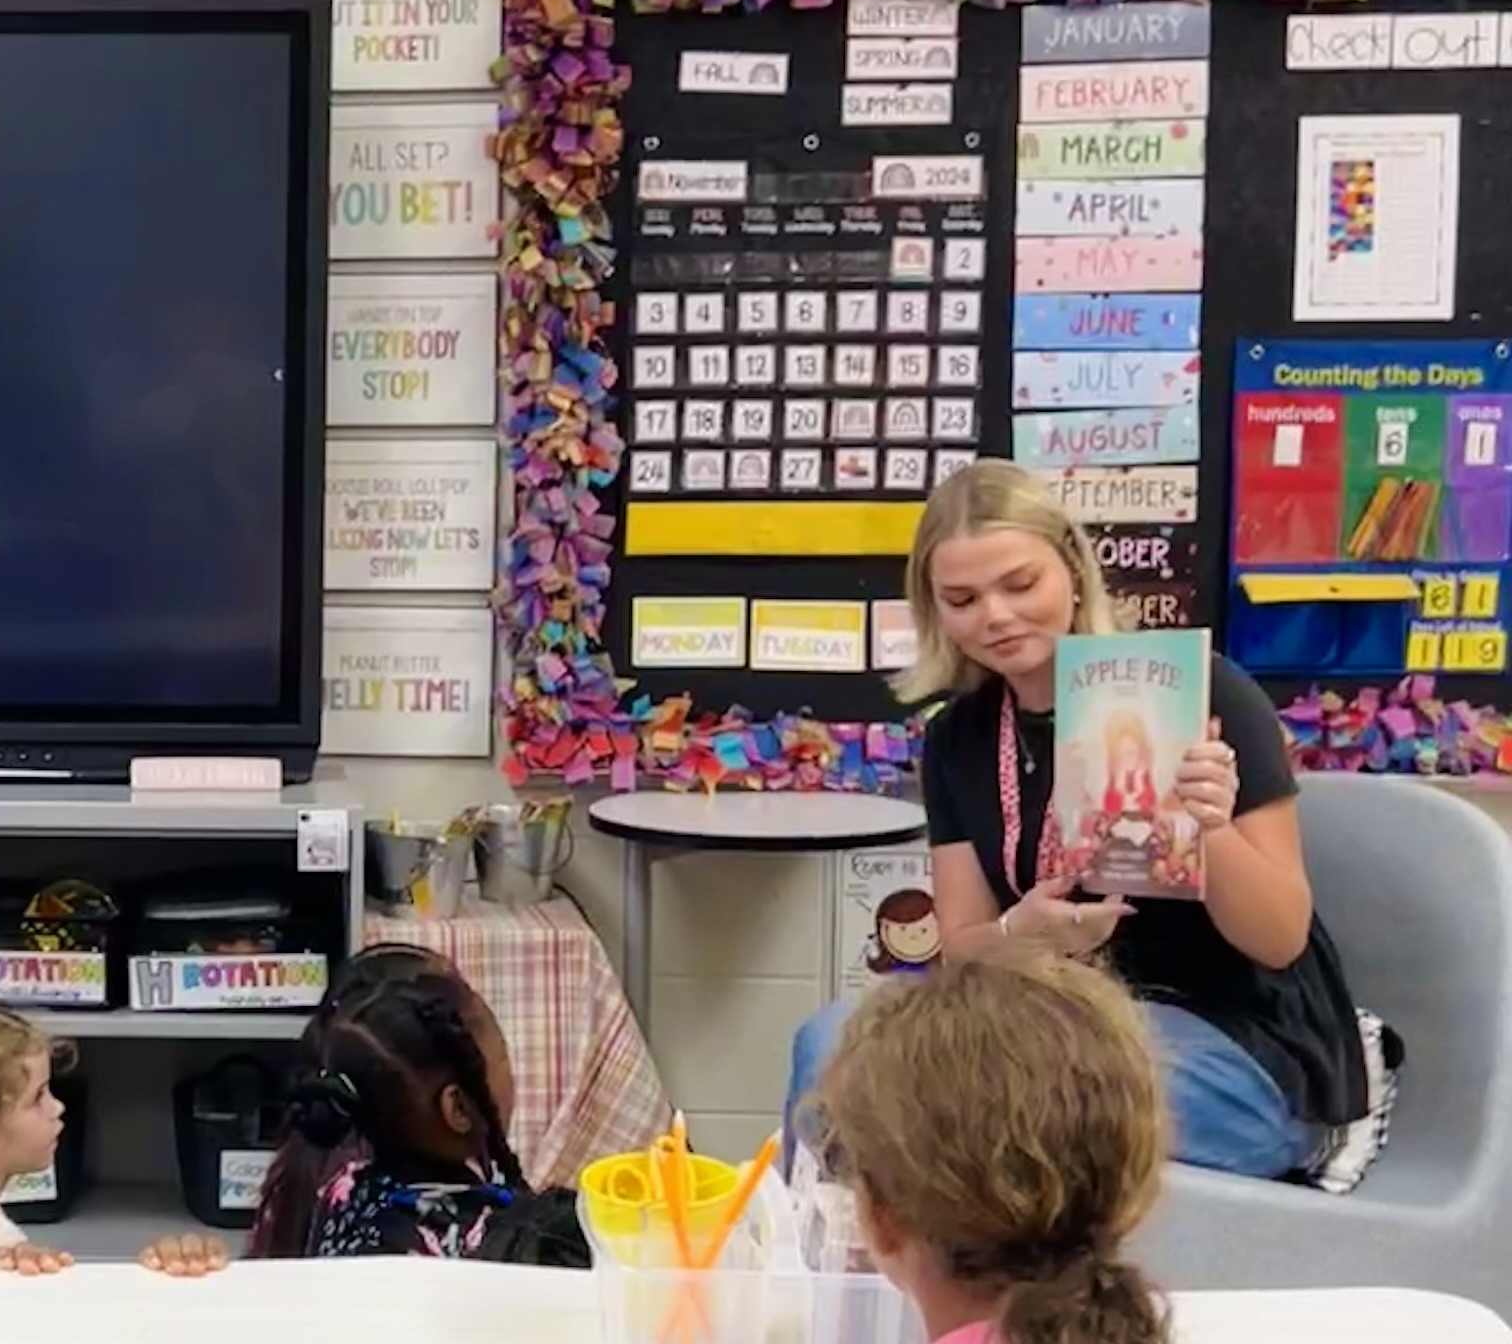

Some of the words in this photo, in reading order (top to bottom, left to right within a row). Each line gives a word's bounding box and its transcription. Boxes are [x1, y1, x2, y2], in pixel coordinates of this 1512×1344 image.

[1043, 13, 1186, 52] JANUARY
[1289, 19, 1387, 63] Check
[353, 34, 441, 63] POCKET!
[854, 49, 921, 67] SPRING
[692, 64, 740, 82] FALL
[846, 95, 926, 116] SUMMER
[1035, 76, 1191, 109] FEBRUARY
[349, 142, 388, 172] ALL
[394, 140, 449, 172] SET?
[1060, 134, 1162, 164] MARCH
[925, 167, 971, 187] 2024
[400, 180, 474, 226] BET!
[1067, 193, 1150, 224] APRIL
[959, 246, 971, 268] 2
[1075, 247, 1136, 275] MAY
[649, 302, 664, 323] 3
[697, 302, 711, 322] 4
[750, 302, 765, 322] 5
[798, 302, 812, 322] 6
[850, 301, 865, 323] 7
[900, 302, 913, 322] 8
[953, 302, 967, 320] 9
[1068, 307, 1147, 338] JUNE
[331, 329, 461, 362] EVERYBODY
[645, 356, 667, 377] 10
[703, 355, 720, 376] 11
[746, 355, 768, 376] 12
[796, 356, 817, 376] 13
[843, 356, 866, 377] 14
[899, 356, 920, 376] 15
[949, 355, 970, 376] 16
[1067, 362, 1143, 394] JULY
[1273, 363, 1379, 389] Counting
[1383, 363, 1422, 386] the
[1427, 363, 1485, 389] Days
[362, 369, 429, 400] STOP!
[645, 409, 667, 430] 17
[692, 409, 715, 430] 18
[742, 409, 764, 430] 19
[791, 408, 818, 428] 20
[941, 407, 967, 427] 23
[1247, 404, 1337, 423] hundreds
[1048, 421, 1166, 455] AUGUST
[1384, 431, 1403, 457] 6
[1477, 431, 1486, 456] 1
[635, 462, 665, 482] 24
[788, 458, 814, 479] 27
[893, 458, 918, 478] 29
[1096, 536, 1170, 570] OBER
[640, 630, 735, 655] MONDAY
[1068, 657, 1140, 693] APPLE
[1145, 659, 1183, 691] PIE
[324, 677, 385, 712] ELLY
[391, 677, 471, 713] TIME!
[137, 959, 174, 1006] H
[181, 961, 328, 990] ROTATION
